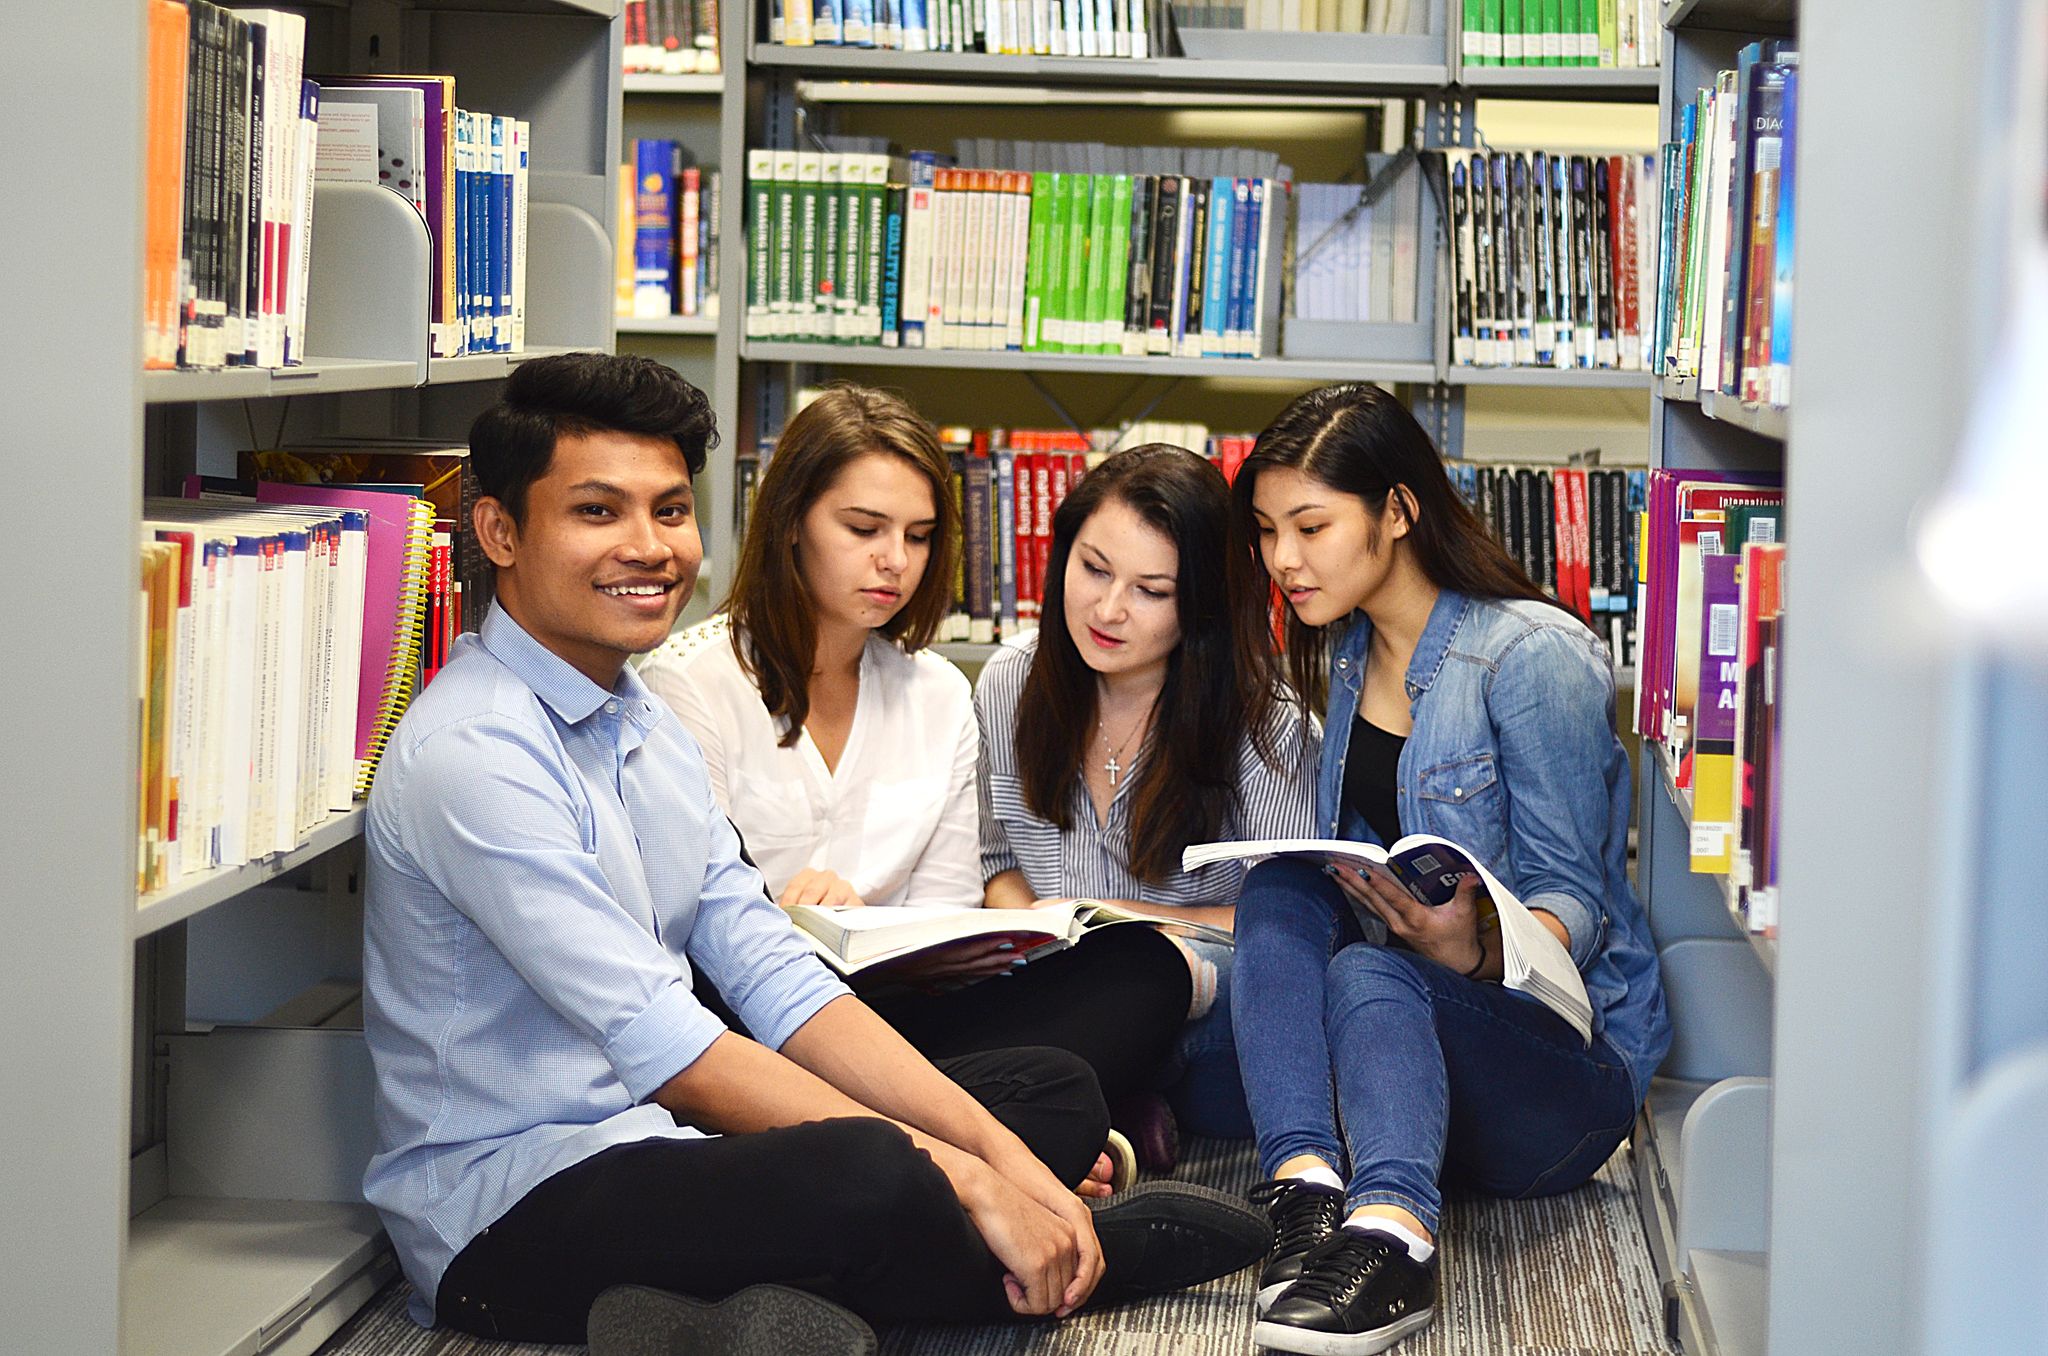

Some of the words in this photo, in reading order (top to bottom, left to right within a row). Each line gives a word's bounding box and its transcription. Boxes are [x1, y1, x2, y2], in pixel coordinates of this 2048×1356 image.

[759, 193, 769, 249] MANAGING
[782, 194, 792, 249] MANAGING
[805, 195, 815, 250] MANAGING
[828, 196, 837, 252] MANAGING
[848, 196, 858, 252] MANAGING
[871, 198, 881, 253] MANAGING
[885, 214, 901, 280] QUALITY
[885, 281, 898, 294] IS
[1017, 469, 1031, 535] marketing
[1036, 469, 1050, 536] marketing
[1571, 477, 1589, 568] INTERNATIONAL
[1612, 540, 1624, 592] marketing
